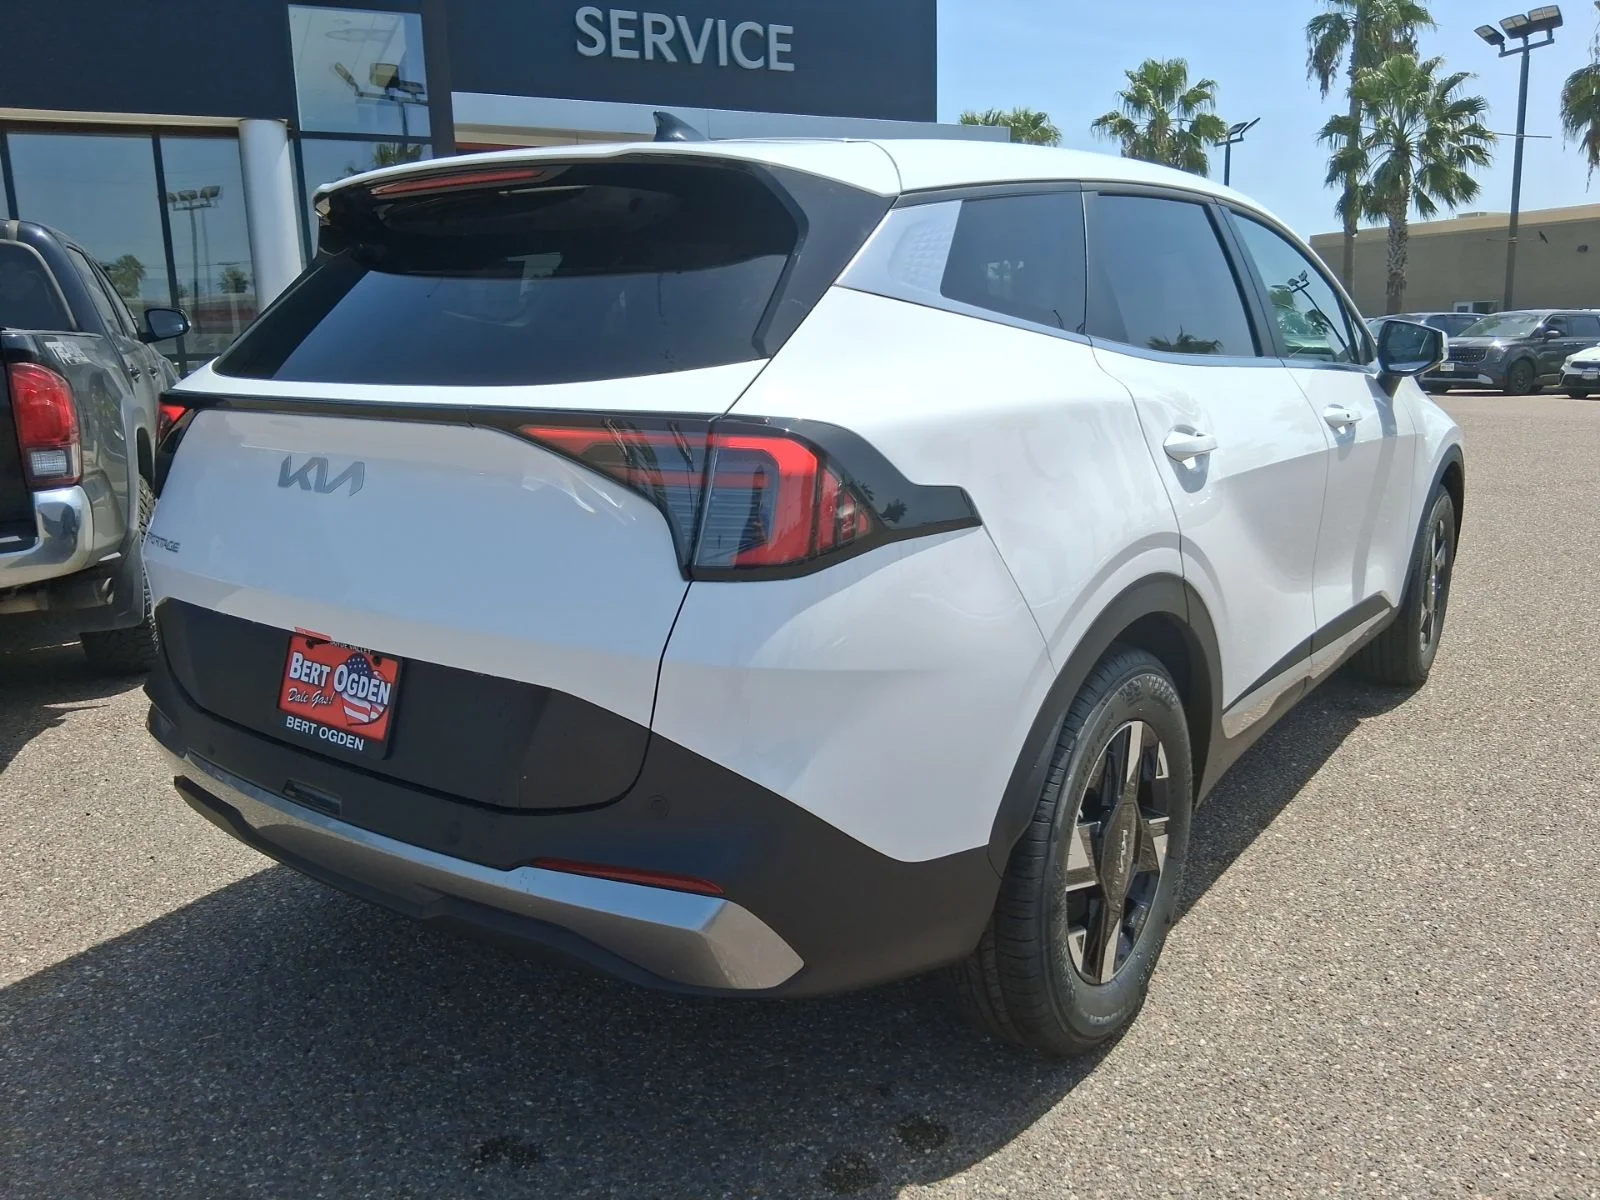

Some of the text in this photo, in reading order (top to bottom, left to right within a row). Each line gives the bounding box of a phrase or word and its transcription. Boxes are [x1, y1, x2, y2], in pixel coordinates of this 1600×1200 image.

[575, 6, 795, 72] SERVICE
[288, 687, 336, 708] Dale Gas!
[289, 652, 392, 705] BERT OGDEN
[286, 715, 364, 751] BERT OGDEN
